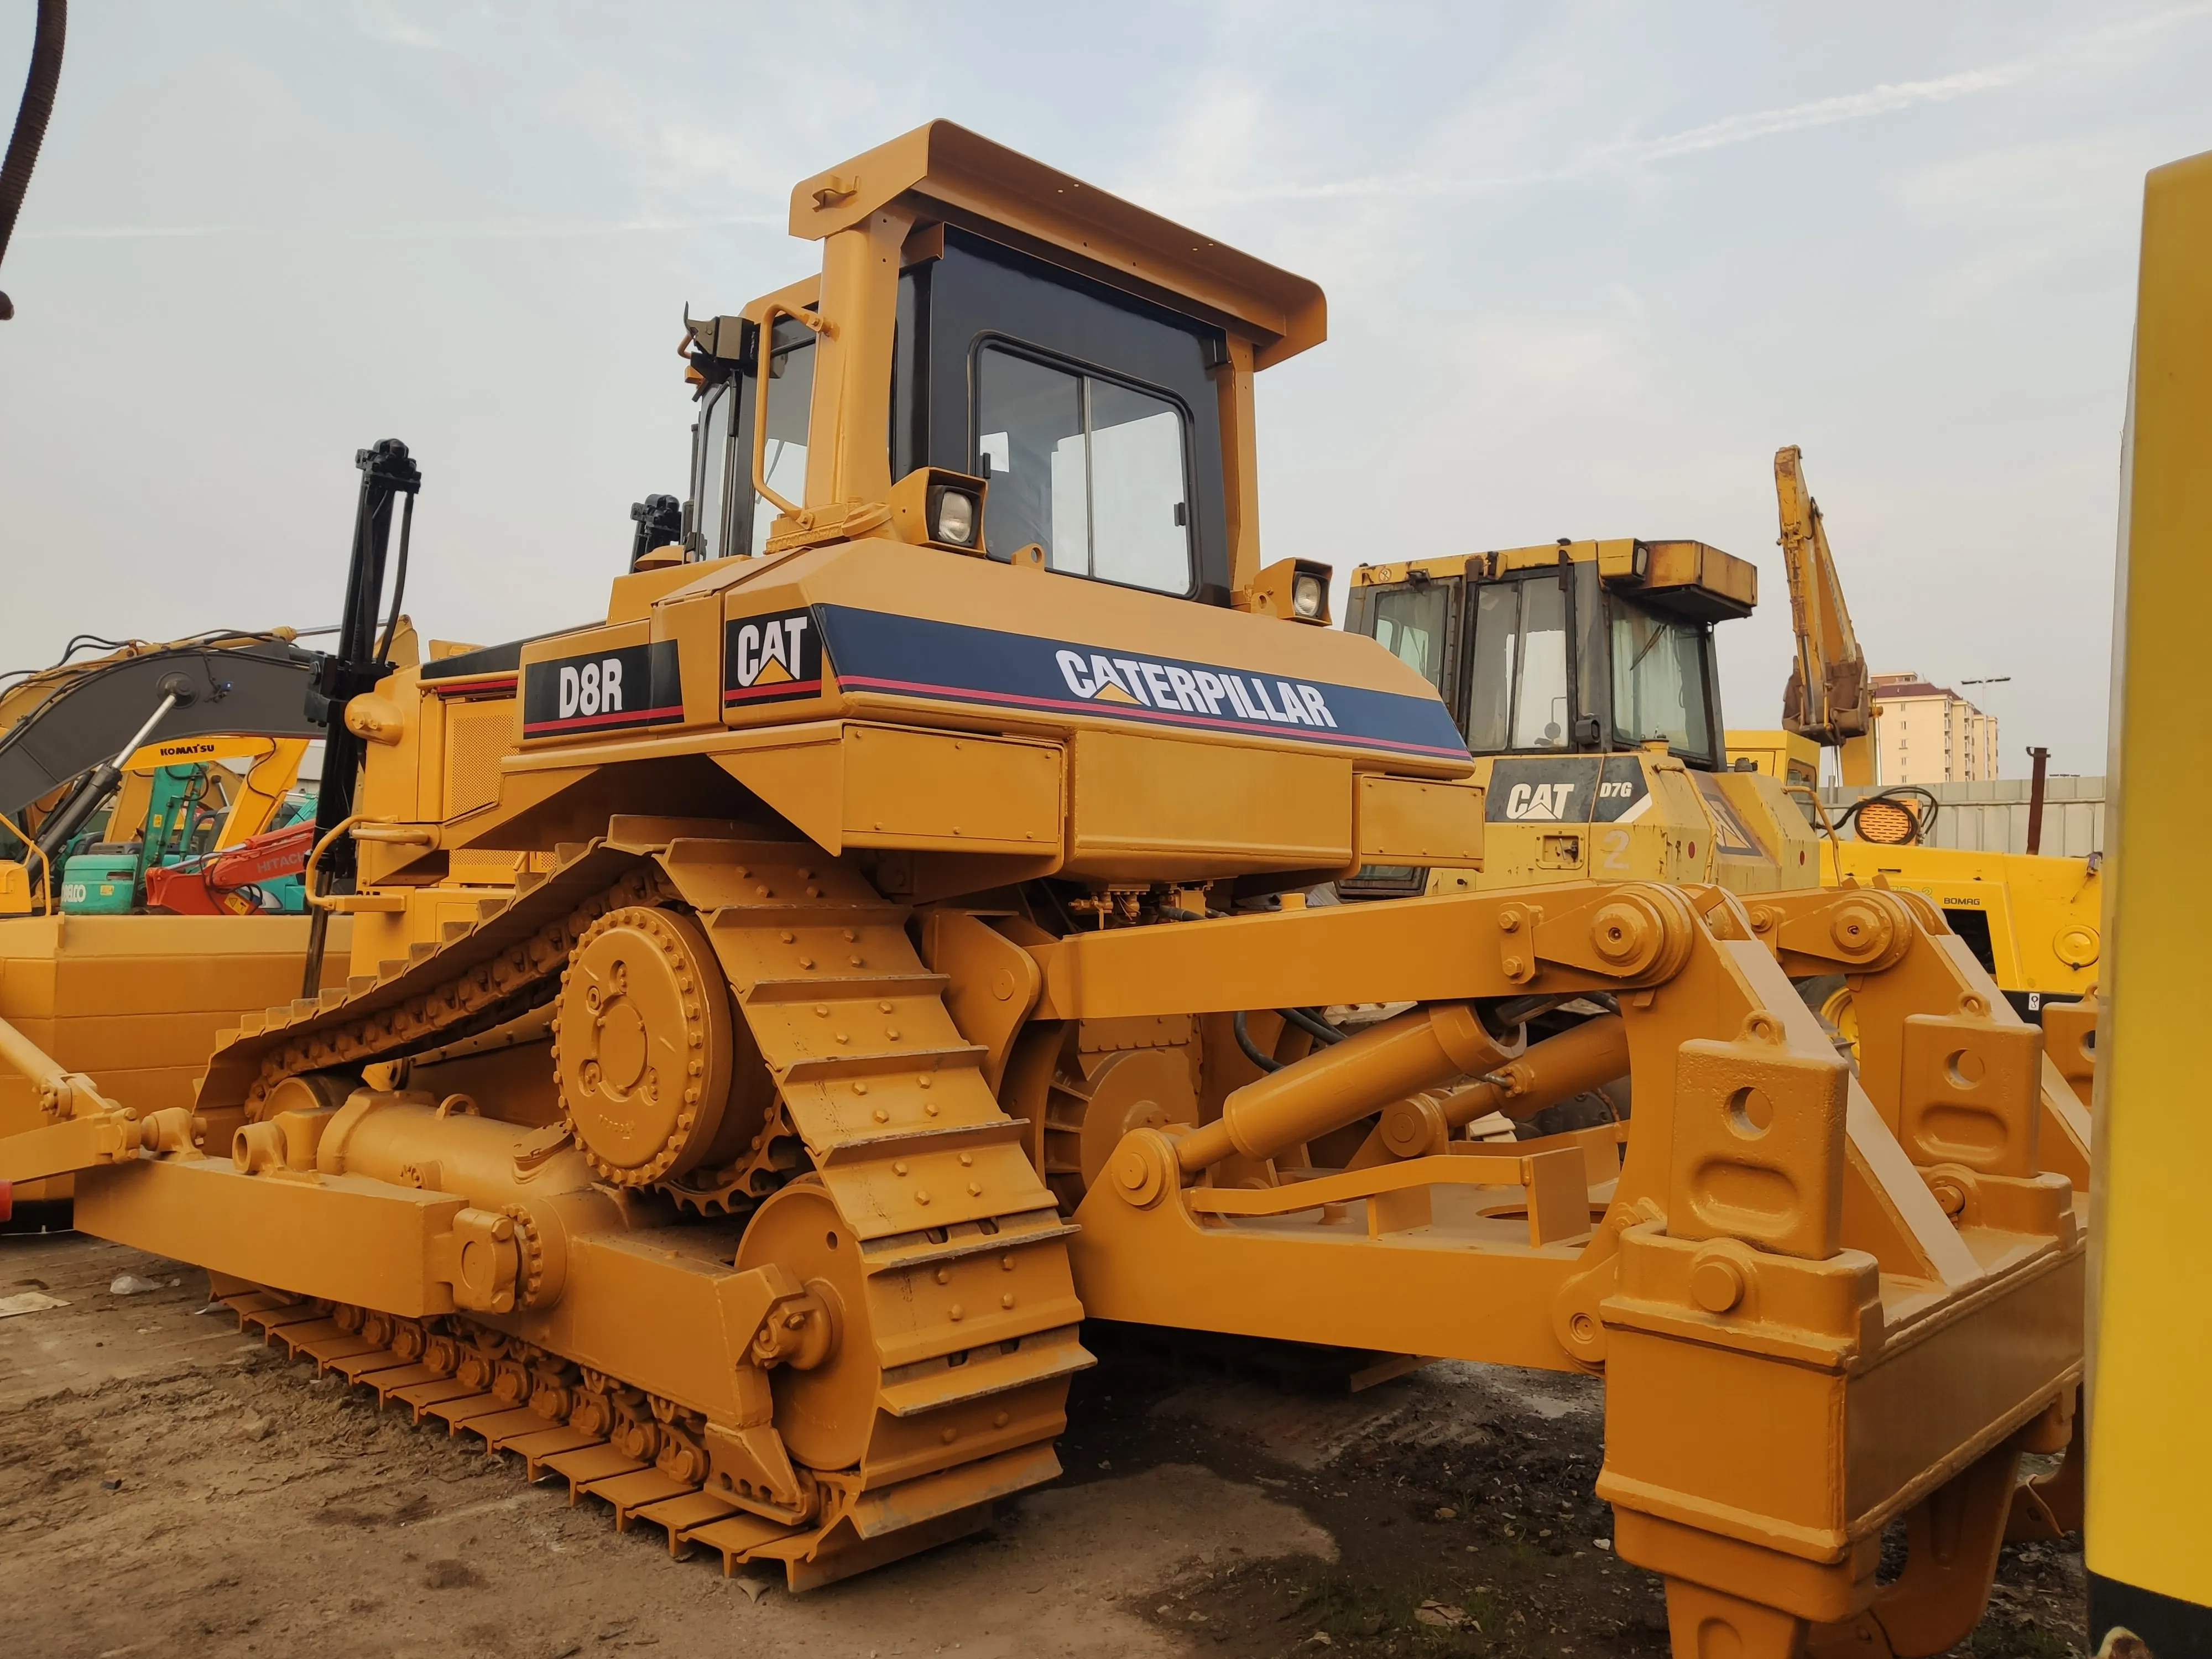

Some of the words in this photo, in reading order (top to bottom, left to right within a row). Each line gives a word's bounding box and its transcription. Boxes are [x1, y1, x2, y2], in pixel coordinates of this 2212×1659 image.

[737, 616, 807, 687] CAT
[559, 658, 623, 719] D8R
[1055, 650, 1338, 728] CATERPILLAR
[160, 744, 215, 756] KOMATSU
[1506, 783, 1575, 820] CAT
[1599, 781, 1632, 797] D7G
[1708, 800, 1752, 849] AT
[257, 852, 304, 874] HITACH
[1603, 830, 1631, 870] 2
